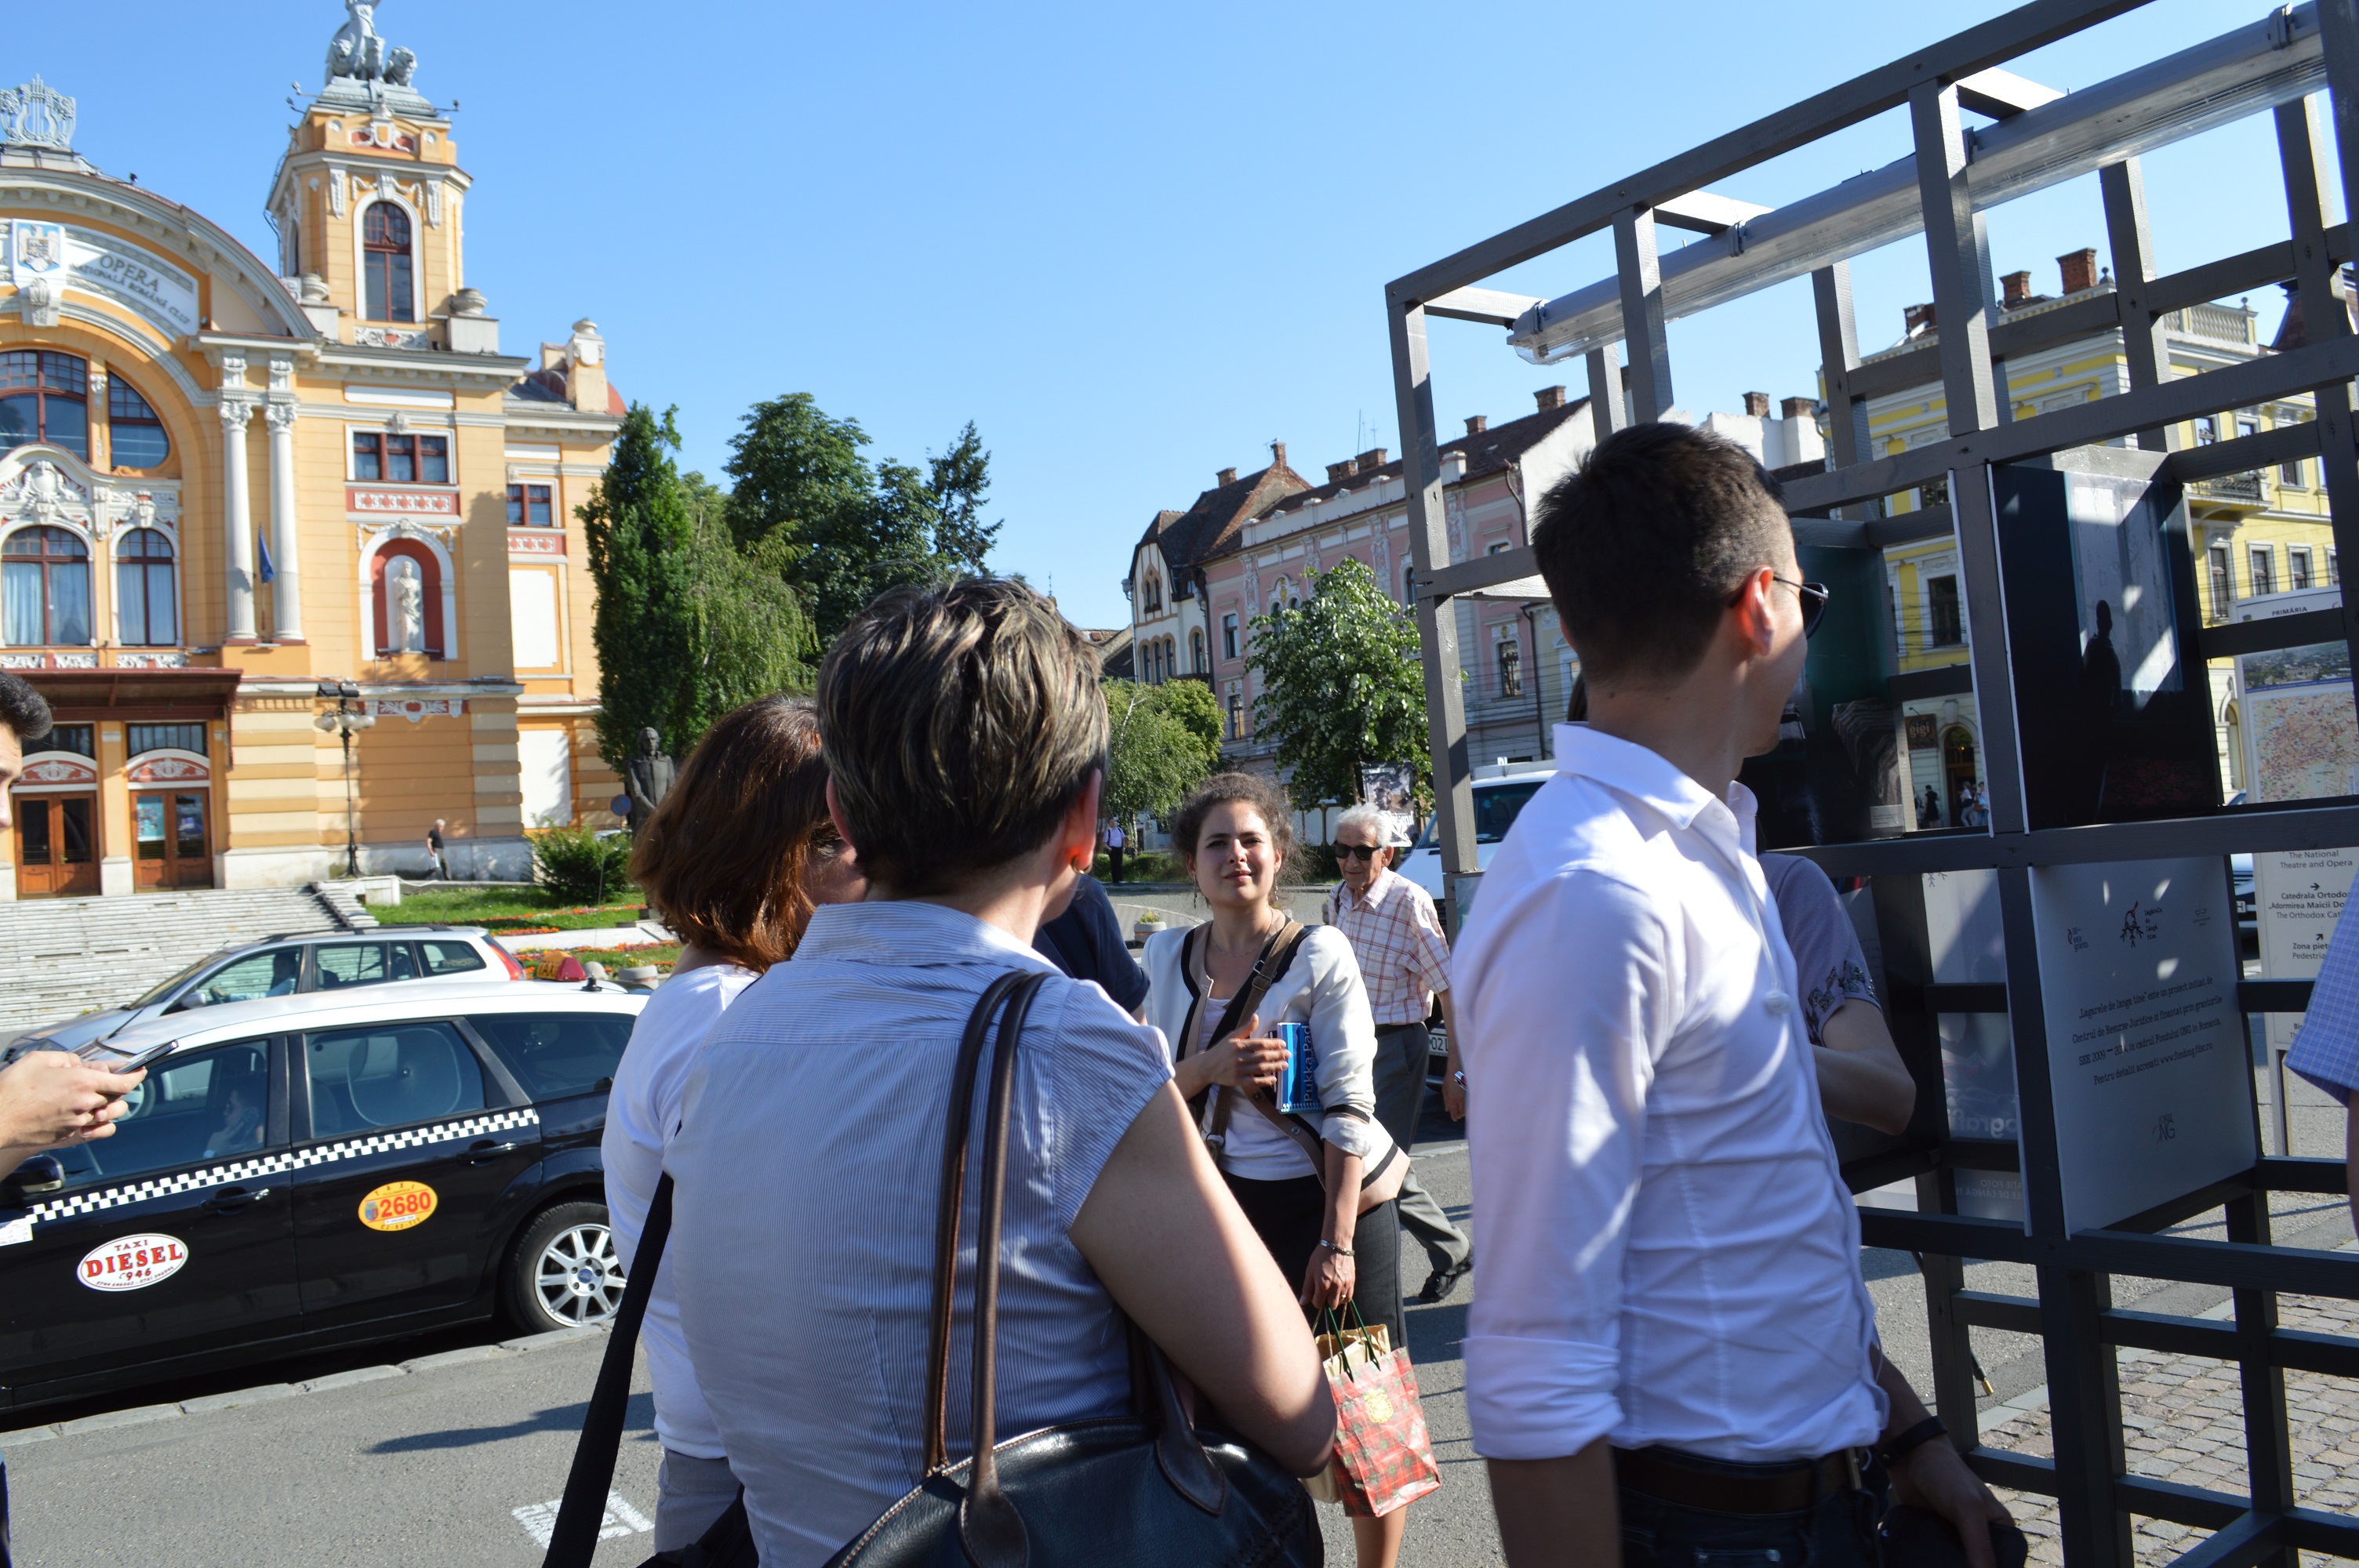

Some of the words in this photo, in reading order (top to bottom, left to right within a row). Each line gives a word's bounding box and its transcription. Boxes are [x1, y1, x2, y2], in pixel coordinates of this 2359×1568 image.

[100, 254, 159, 292] OPERA
[1909, 722, 1930, 739] gigi
[2304, 850, 2339, 858] National
[2326, 859, 2353, 869] Opera
[2317, 891, 2350, 899] Ortodo
[2306, 901, 2331, 909] Maicii
[2276, 911, 2288, 920] The
[2107, 1001, 2116, 1011] de
[2116, 997, 2132, 1010] langa
[2147, 991, 2160, 1000] este
[2168, 982, 2188, 998] proiect
[2206, 975, 2214, 985] de
[2072, 1029, 2096, 1044] Centrul
[2097, 1026, 2105, 1038] de
[2105, 1021, 2128, 1035] Resurse
[2129, 1014, 2154, 1029] Juridice
[2183, 1003, 2195, 1016] prin
[2195, 995, 2223, 1012] granturile
[1301, 1025, 1312, 1052] Pad
[2078, 1053, 2092, 1066] SEE
[2092, 1050, 2106, 1063] 2009
[2128, 1042, 2135, 1052] in
[2135, 1034, 2155, 1050] cadrul
[2154, 1029, 2179, 1044] Fondului
[2179, 1024, 2193, 1036] ONG
[2192, 1023, 2198, 1033] in
[1303, 1057, 1313, 1102] Pukka
[2093, 1072, 2115, 1086] Pentru
[2115, 1064, 2135, 1078] detalii
[374, 1183, 415, 1196] TAXI
[380, 1191, 431, 1218] 2680
[114, 1240, 149, 1251] TAXI
[85, 1243, 184, 1278] DIESEL
[125, 1268, 152, 1281] 946
